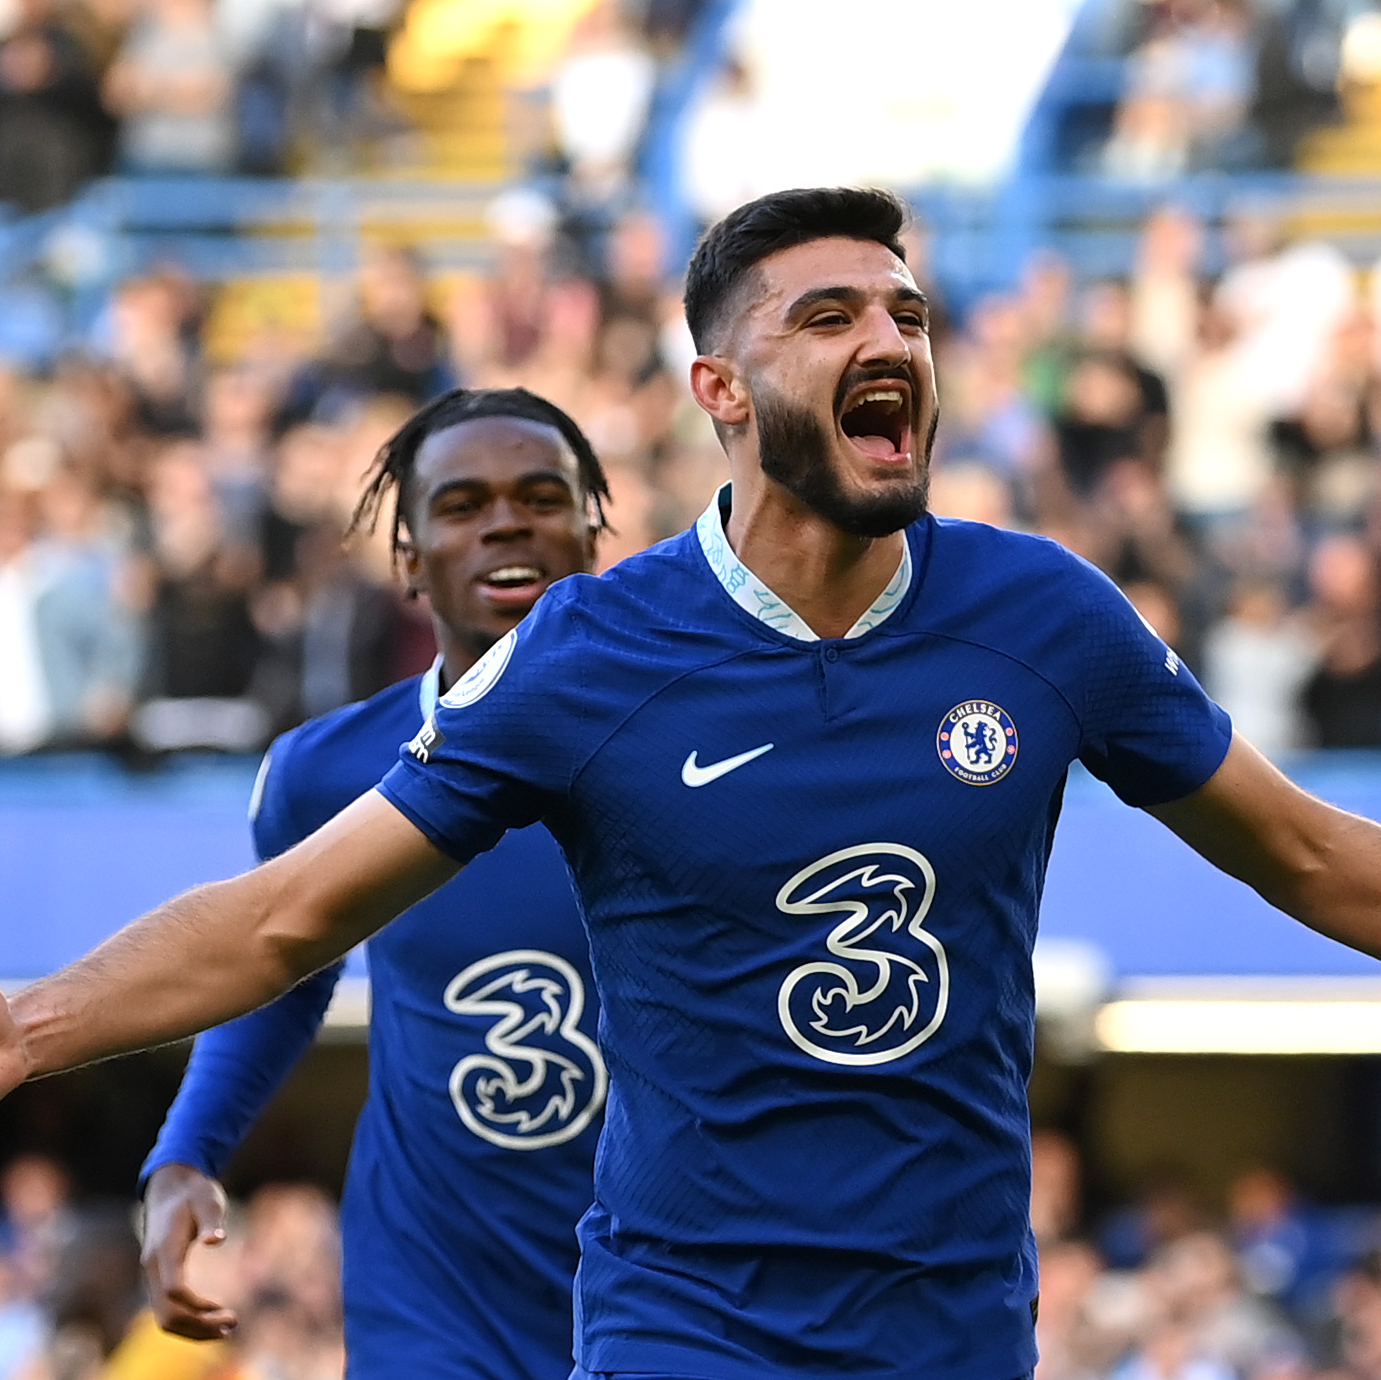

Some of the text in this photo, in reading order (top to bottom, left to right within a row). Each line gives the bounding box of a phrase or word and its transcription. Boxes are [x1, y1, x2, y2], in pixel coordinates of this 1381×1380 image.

[949, 703, 1001, 723] CHELSEA
[954, 766, 990, 782] FOOTBALL
[775, 842, 949, 1066] 3
[443, 949, 608, 1151] 3
